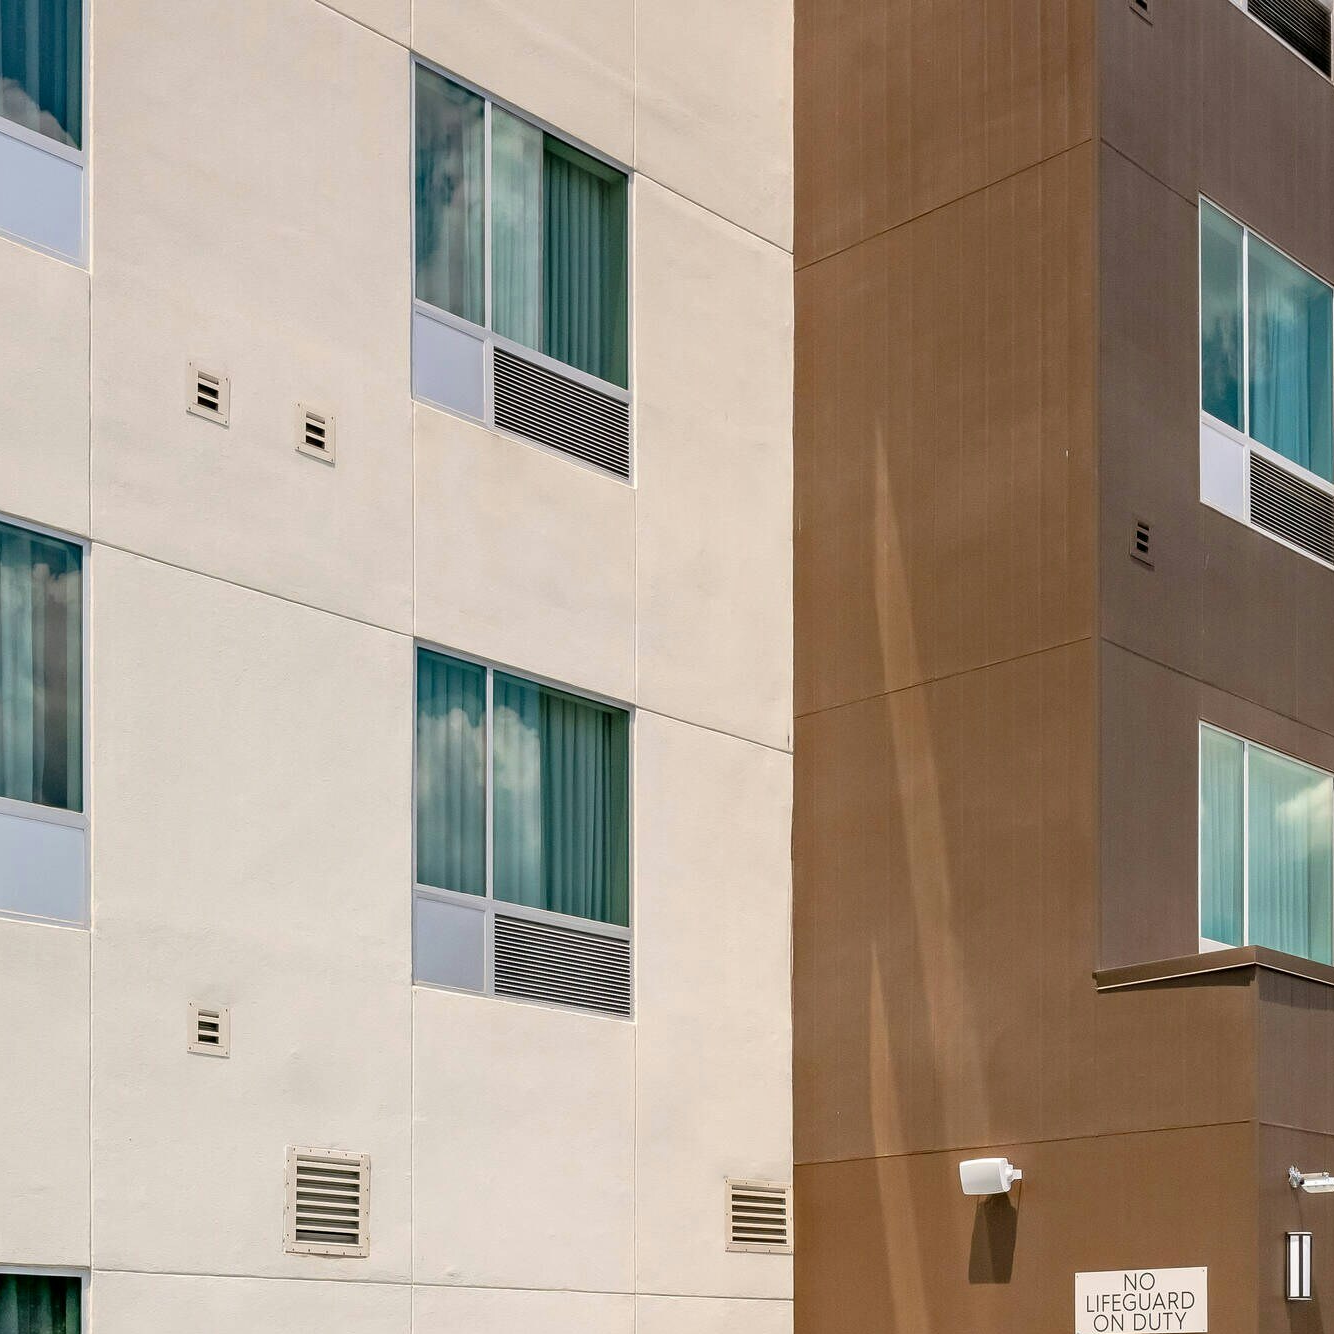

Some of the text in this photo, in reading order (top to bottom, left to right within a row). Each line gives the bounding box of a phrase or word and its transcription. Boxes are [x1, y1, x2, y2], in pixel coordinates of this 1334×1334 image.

[1124, 1272, 1155, 1291] NO
[1087, 1291, 1195, 1312] LIFEGUARD
[1094, 1312, 1187, 1332] ON DUTY
